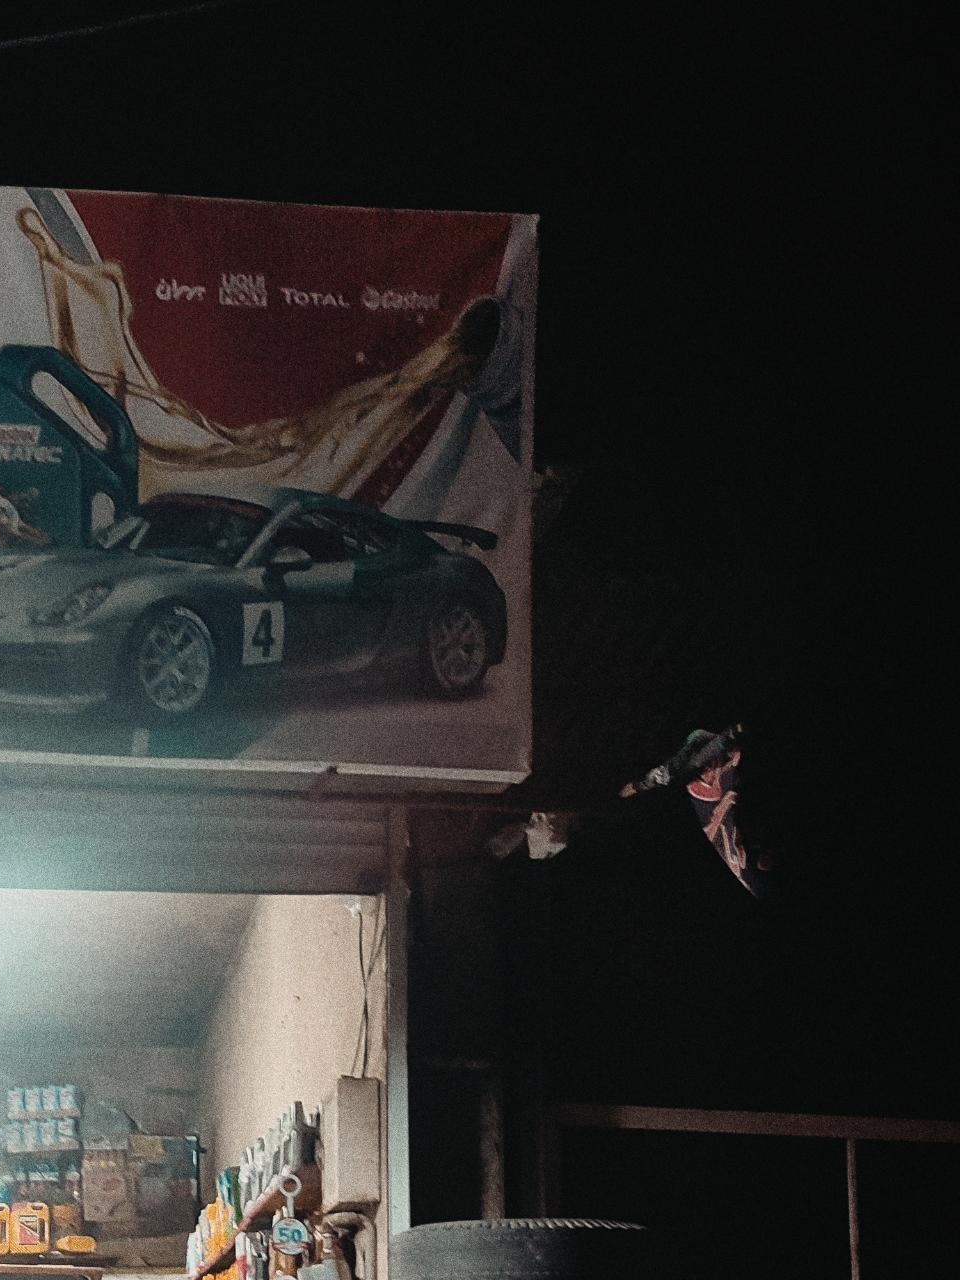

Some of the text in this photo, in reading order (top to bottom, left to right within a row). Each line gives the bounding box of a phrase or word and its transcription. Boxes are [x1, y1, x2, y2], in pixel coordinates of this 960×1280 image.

[280, 287, 351, 308] TOTAL
[251, 609, 275, 658] 4
[278, 1227, 303, 1243] 50
